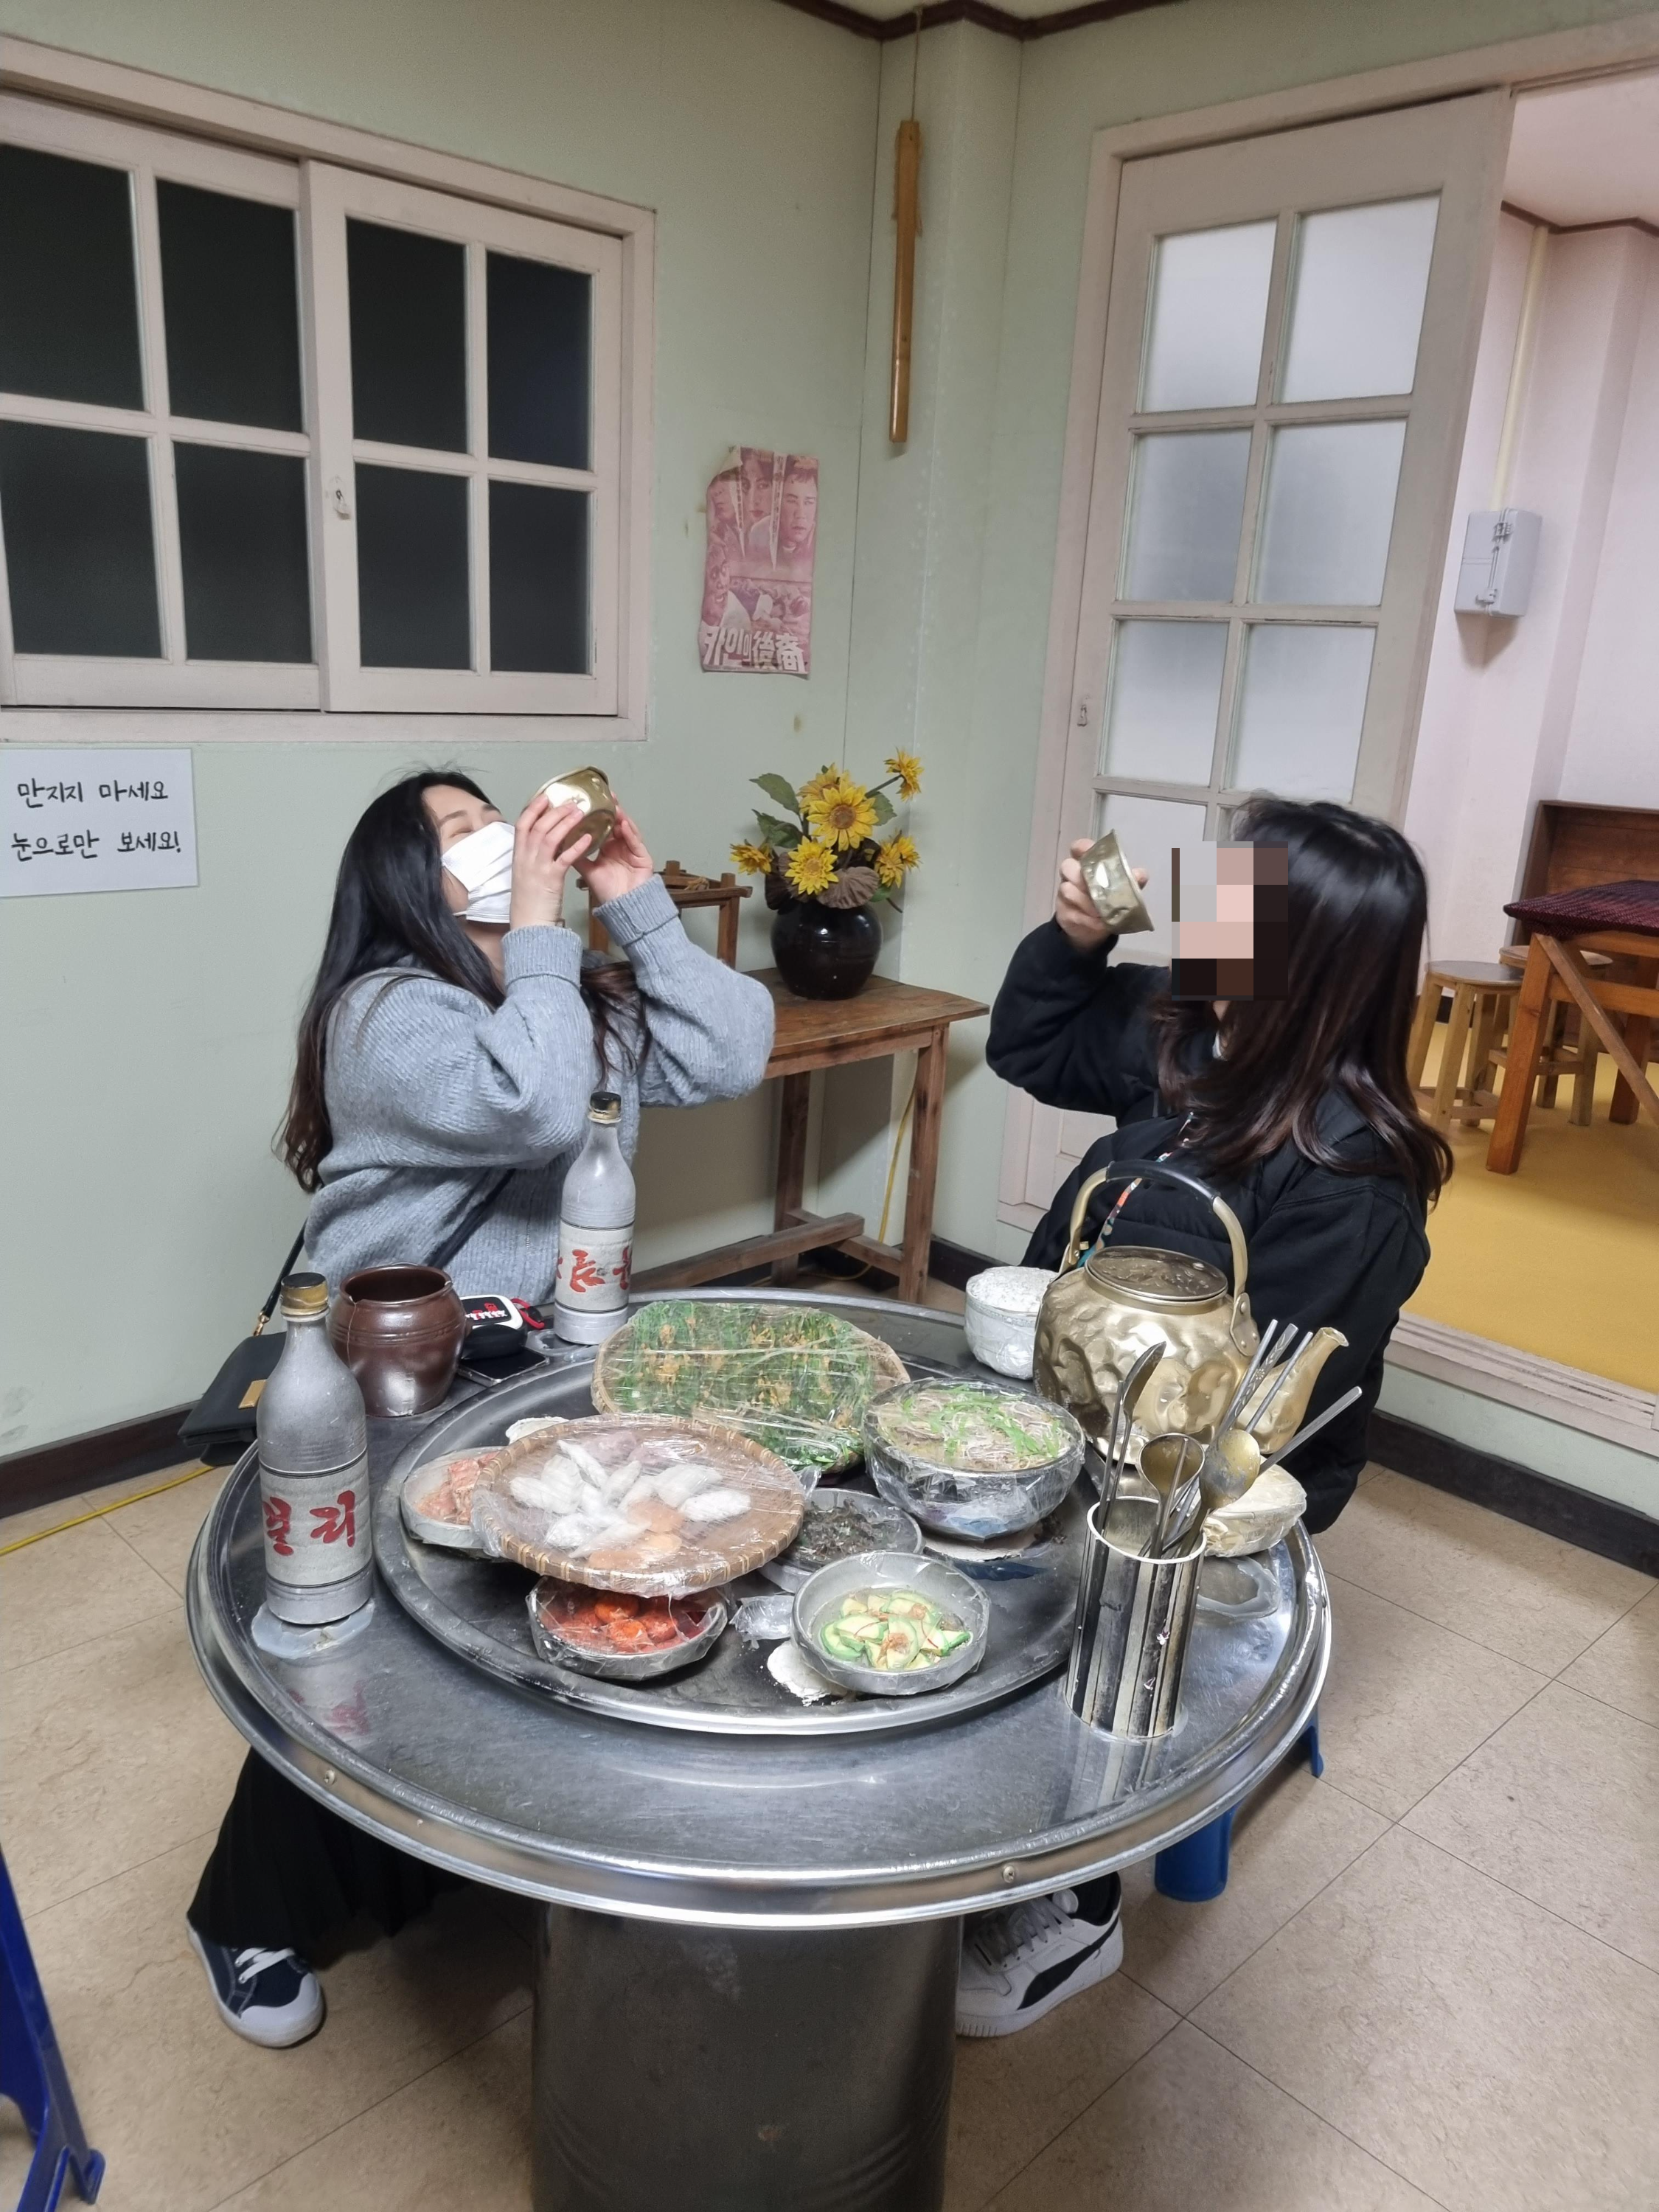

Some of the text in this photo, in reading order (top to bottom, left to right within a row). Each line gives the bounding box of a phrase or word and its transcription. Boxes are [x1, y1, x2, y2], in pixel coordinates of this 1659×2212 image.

[17, 777, 169, 809] 만지지 마세요
[11, 829, 181, 862] 눈으로만 보세요!
